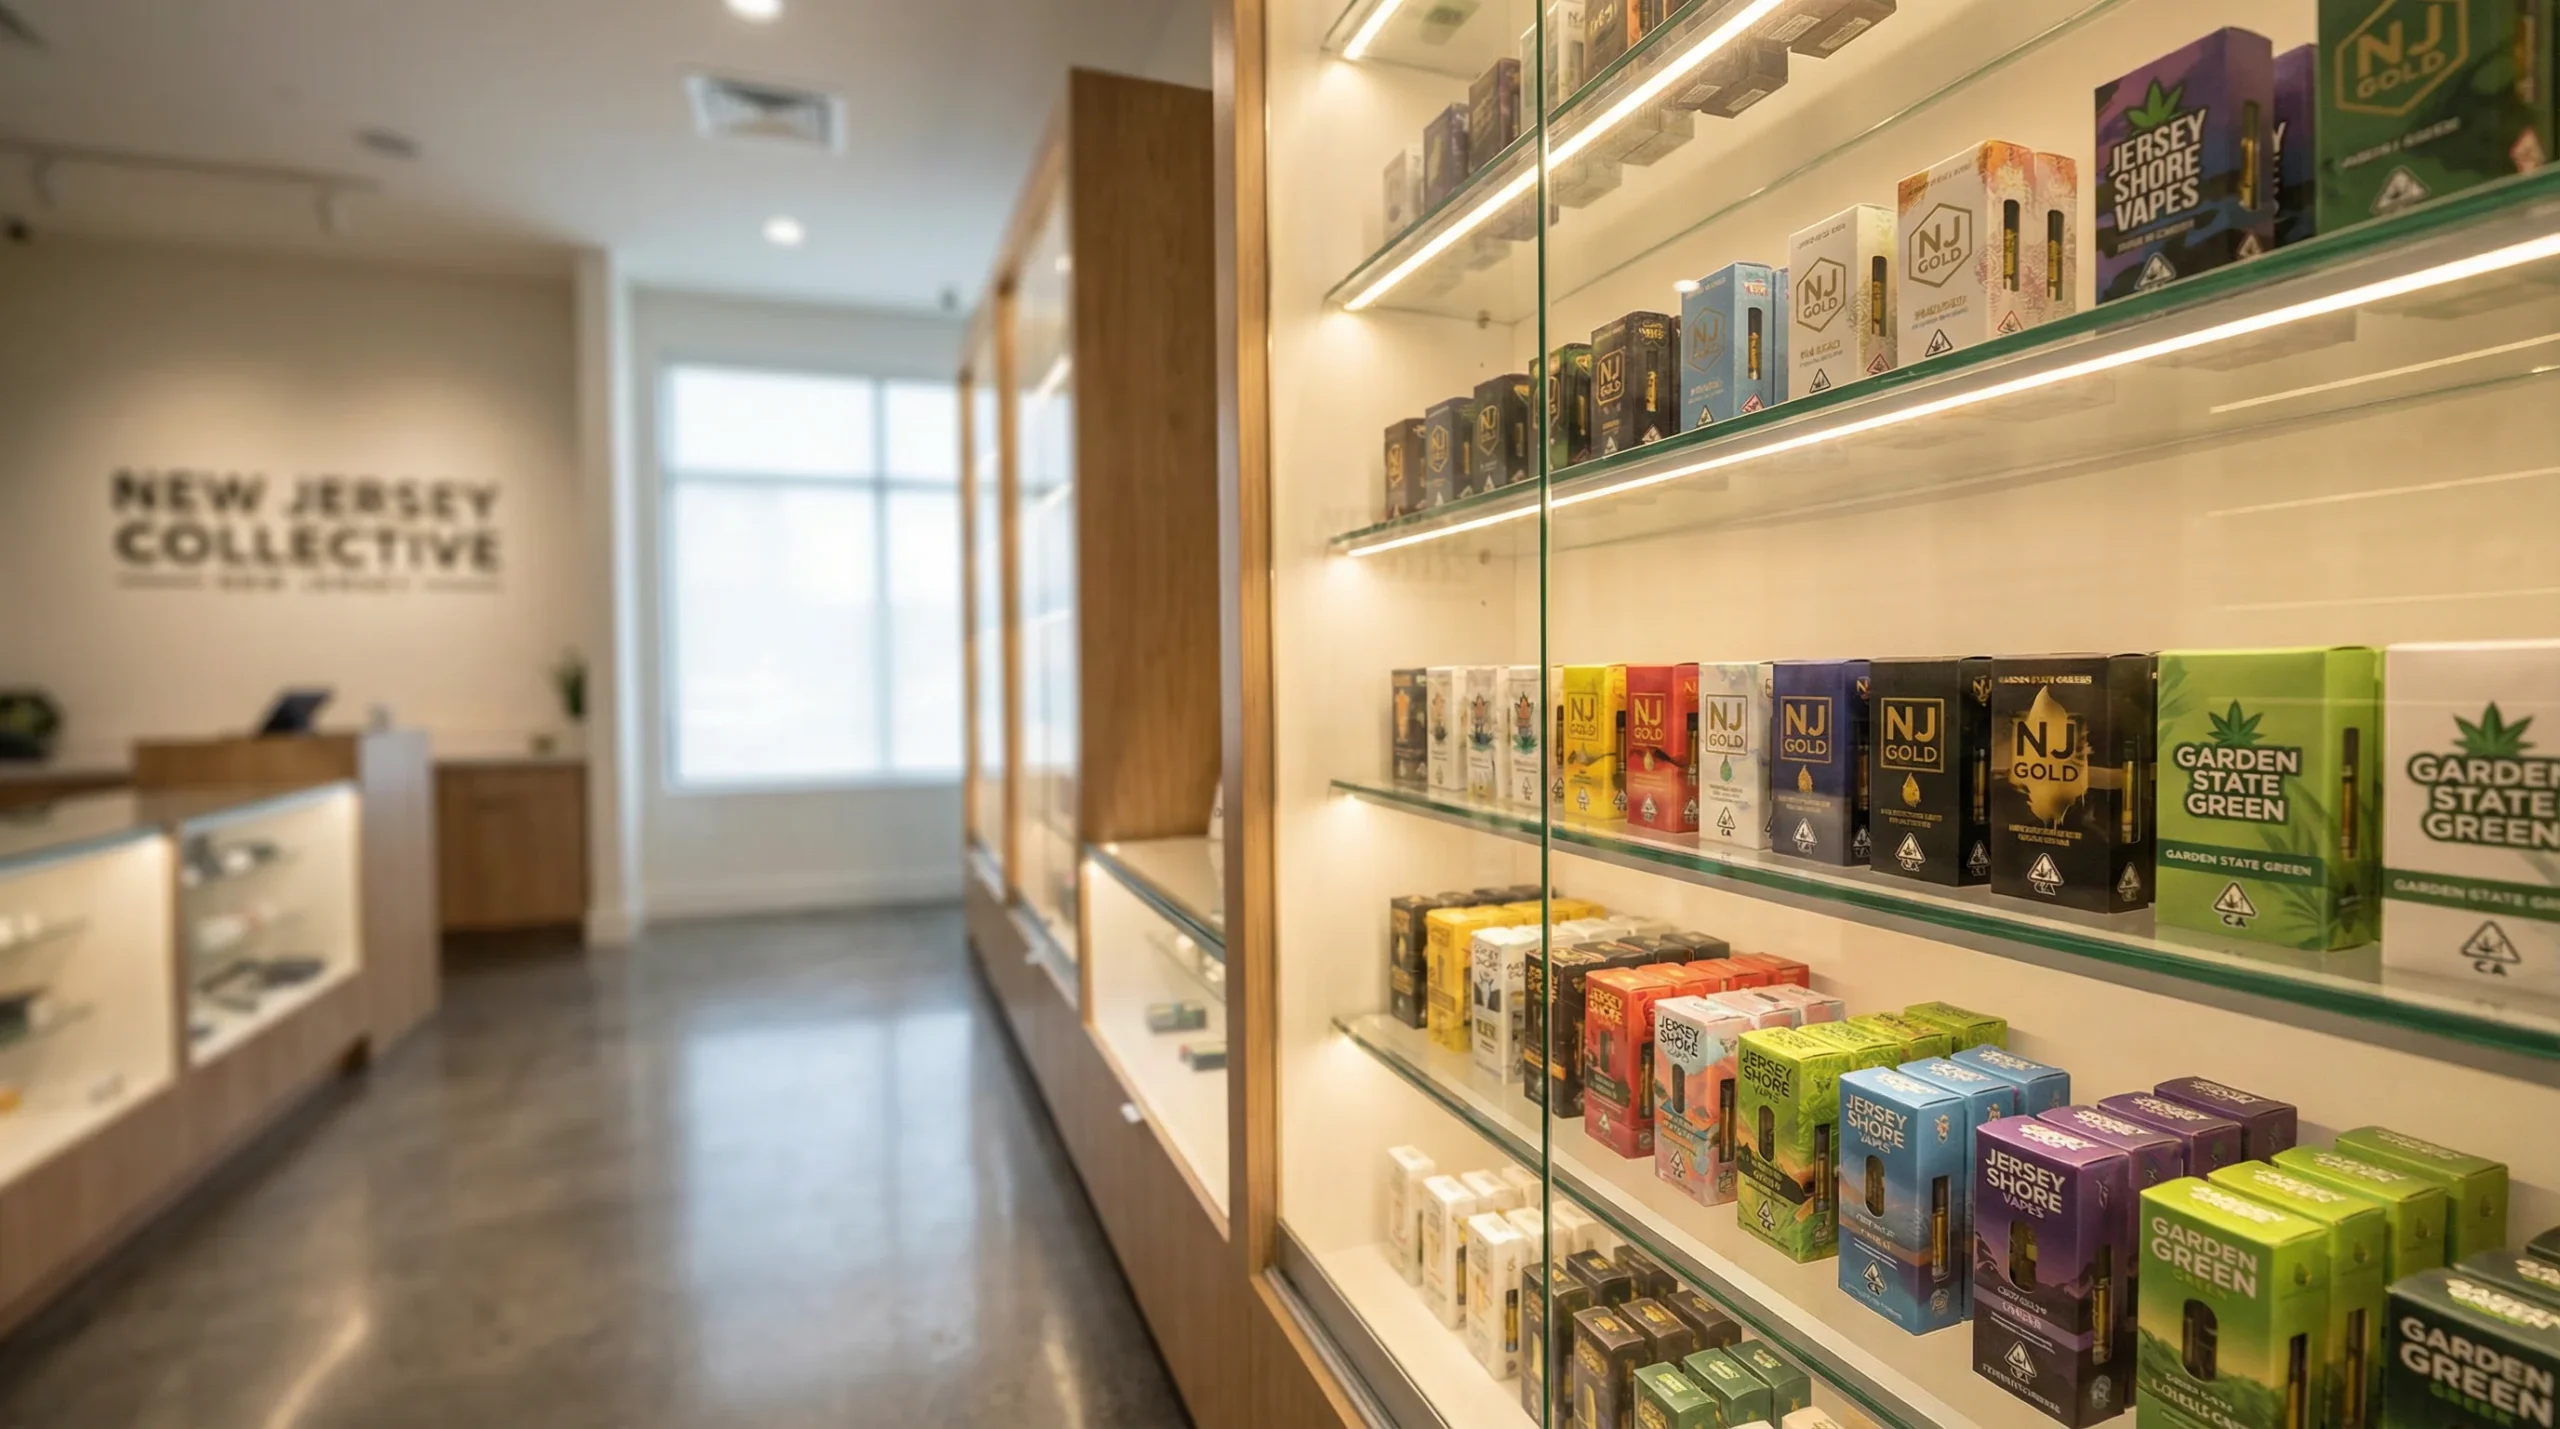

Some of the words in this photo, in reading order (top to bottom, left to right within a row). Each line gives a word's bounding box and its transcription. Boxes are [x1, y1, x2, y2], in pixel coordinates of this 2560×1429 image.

[2357, 4, 2442, 79] NJ
[2356, 50, 2446, 98] GOLD
[2109, 108, 2207, 177] JERSEY
[2114, 143, 2202, 203] SHORE
[2114, 177, 2200, 232] VAPES
[1919, 215, 1960, 258] NJ
[1918, 247, 1962, 274] GOLD
[1804, 268, 1837, 305] NJ
[1803, 296, 1838, 319] GOLD
[1693, 318, 1719, 344] NJ
[1600, 355, 1620, 385] NJ
[113, 470, 267, 514] NEW
[286, 478, 499, 518] JERSEY
[115, 522, 502, 570] COLLECTIVE
[1571, 698, 1595, 722] NJ
[1634, 699, 1662, 726] NJ
[1710, 700, 1742, 731] NJ
[1785, 703, 1825, 736] NJ
[1886, 706, 1936, 742] NJ
[1633, 727, 1664, 741] GOLD
[1709, 733, 1744, 748] GOLD
[1784, 738, 1827, 755] GOLD
[2016, 721, 2076, 760] NJ
[1885, 745, 1938, 763] GOLD
[2176, 746, 2297, 773] GARDEN
[2014, 763, 2079, 782] GOLD
[2193, 770, 2280, 796] STATE
[2187, 793, 2285, 821] GREEN
[2433, 786, 2555, 817] STATE
[2426, 813, 2560, 847] GREEN
[2166, 849, 2217, 864] GARDEN
[2220, 856, 2259, 870] STATE
[2263, 861, 2312, 876] GREEN
[2394, 878, 2465, 899] GARDEN
[2468, 888, 2525, 907] STATE
[2222, 914, 2246, 927] CA
[2473, 960, 2507, 976] CA
[1659, 1015, 1699, 1043] JERSEY
[1744, 1066, 1790, 1098] SHORE
[1846, 1094, 1907, 1130] JERSEY
[1847, 1110, 1904, 1149] SHORE
[1986, 1148, 2065, 1192] JERSEY
[1987, 1168, 2062, 1214] SHORE
[2003, 1192, 2044, 1218] VAPES
[2152, 1216, 2257, 1273] GARDEN
[2151, 1237, 2256, 1299] GREEN
[2400, 1316, 2554, 1397] GARDEN
[2400, 1341, 2553, 1428] GREEN
